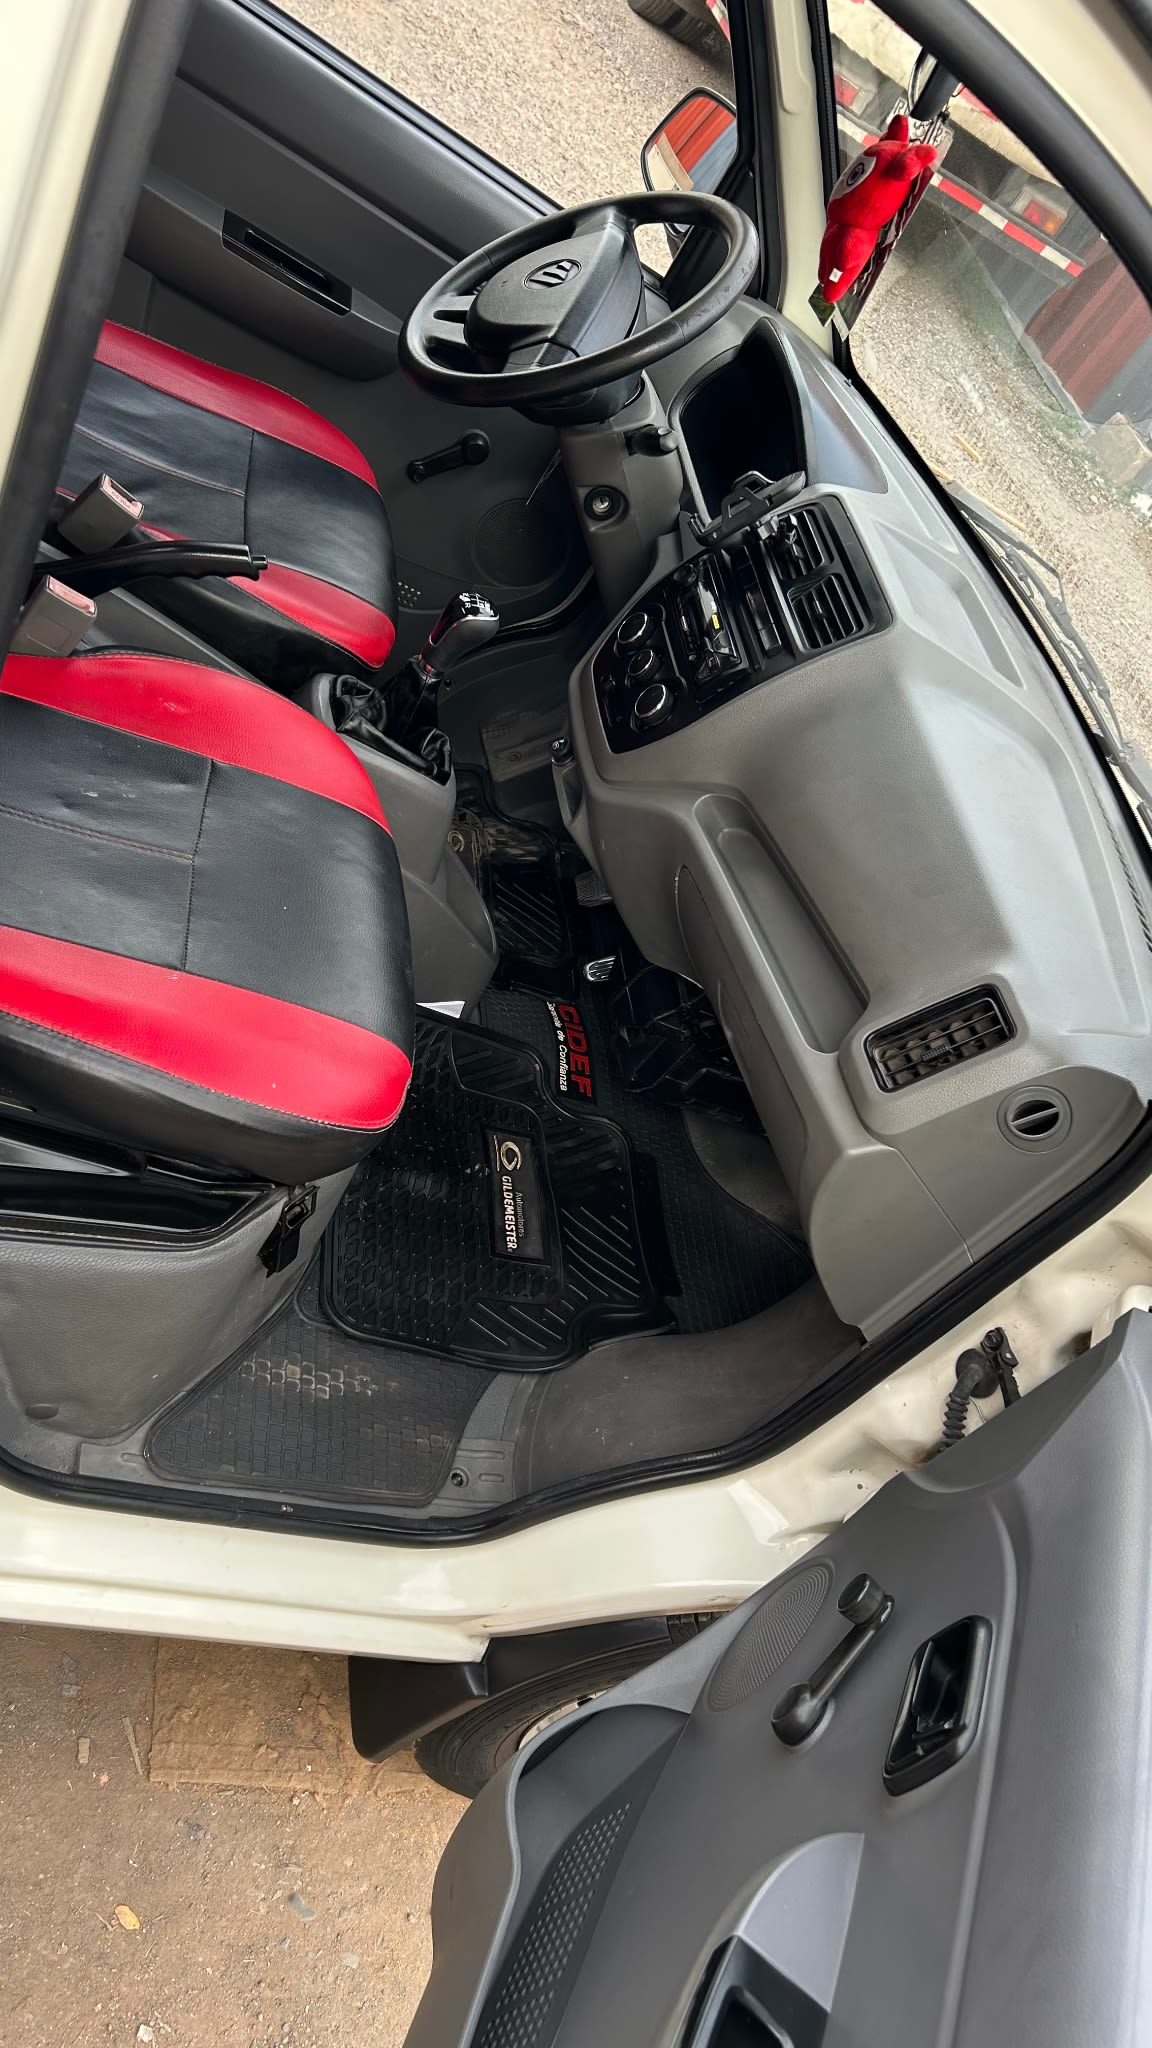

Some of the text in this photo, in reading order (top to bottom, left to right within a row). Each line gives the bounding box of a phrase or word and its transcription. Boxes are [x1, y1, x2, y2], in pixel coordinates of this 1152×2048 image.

[556, 1030, 569, 1091] de Confianza
[558, 1004, 592, 1098] CIDEF
[502, 1175, 518, 1249] GILDEMEISTER
[515, 1191, 525, 1237] Automotores
